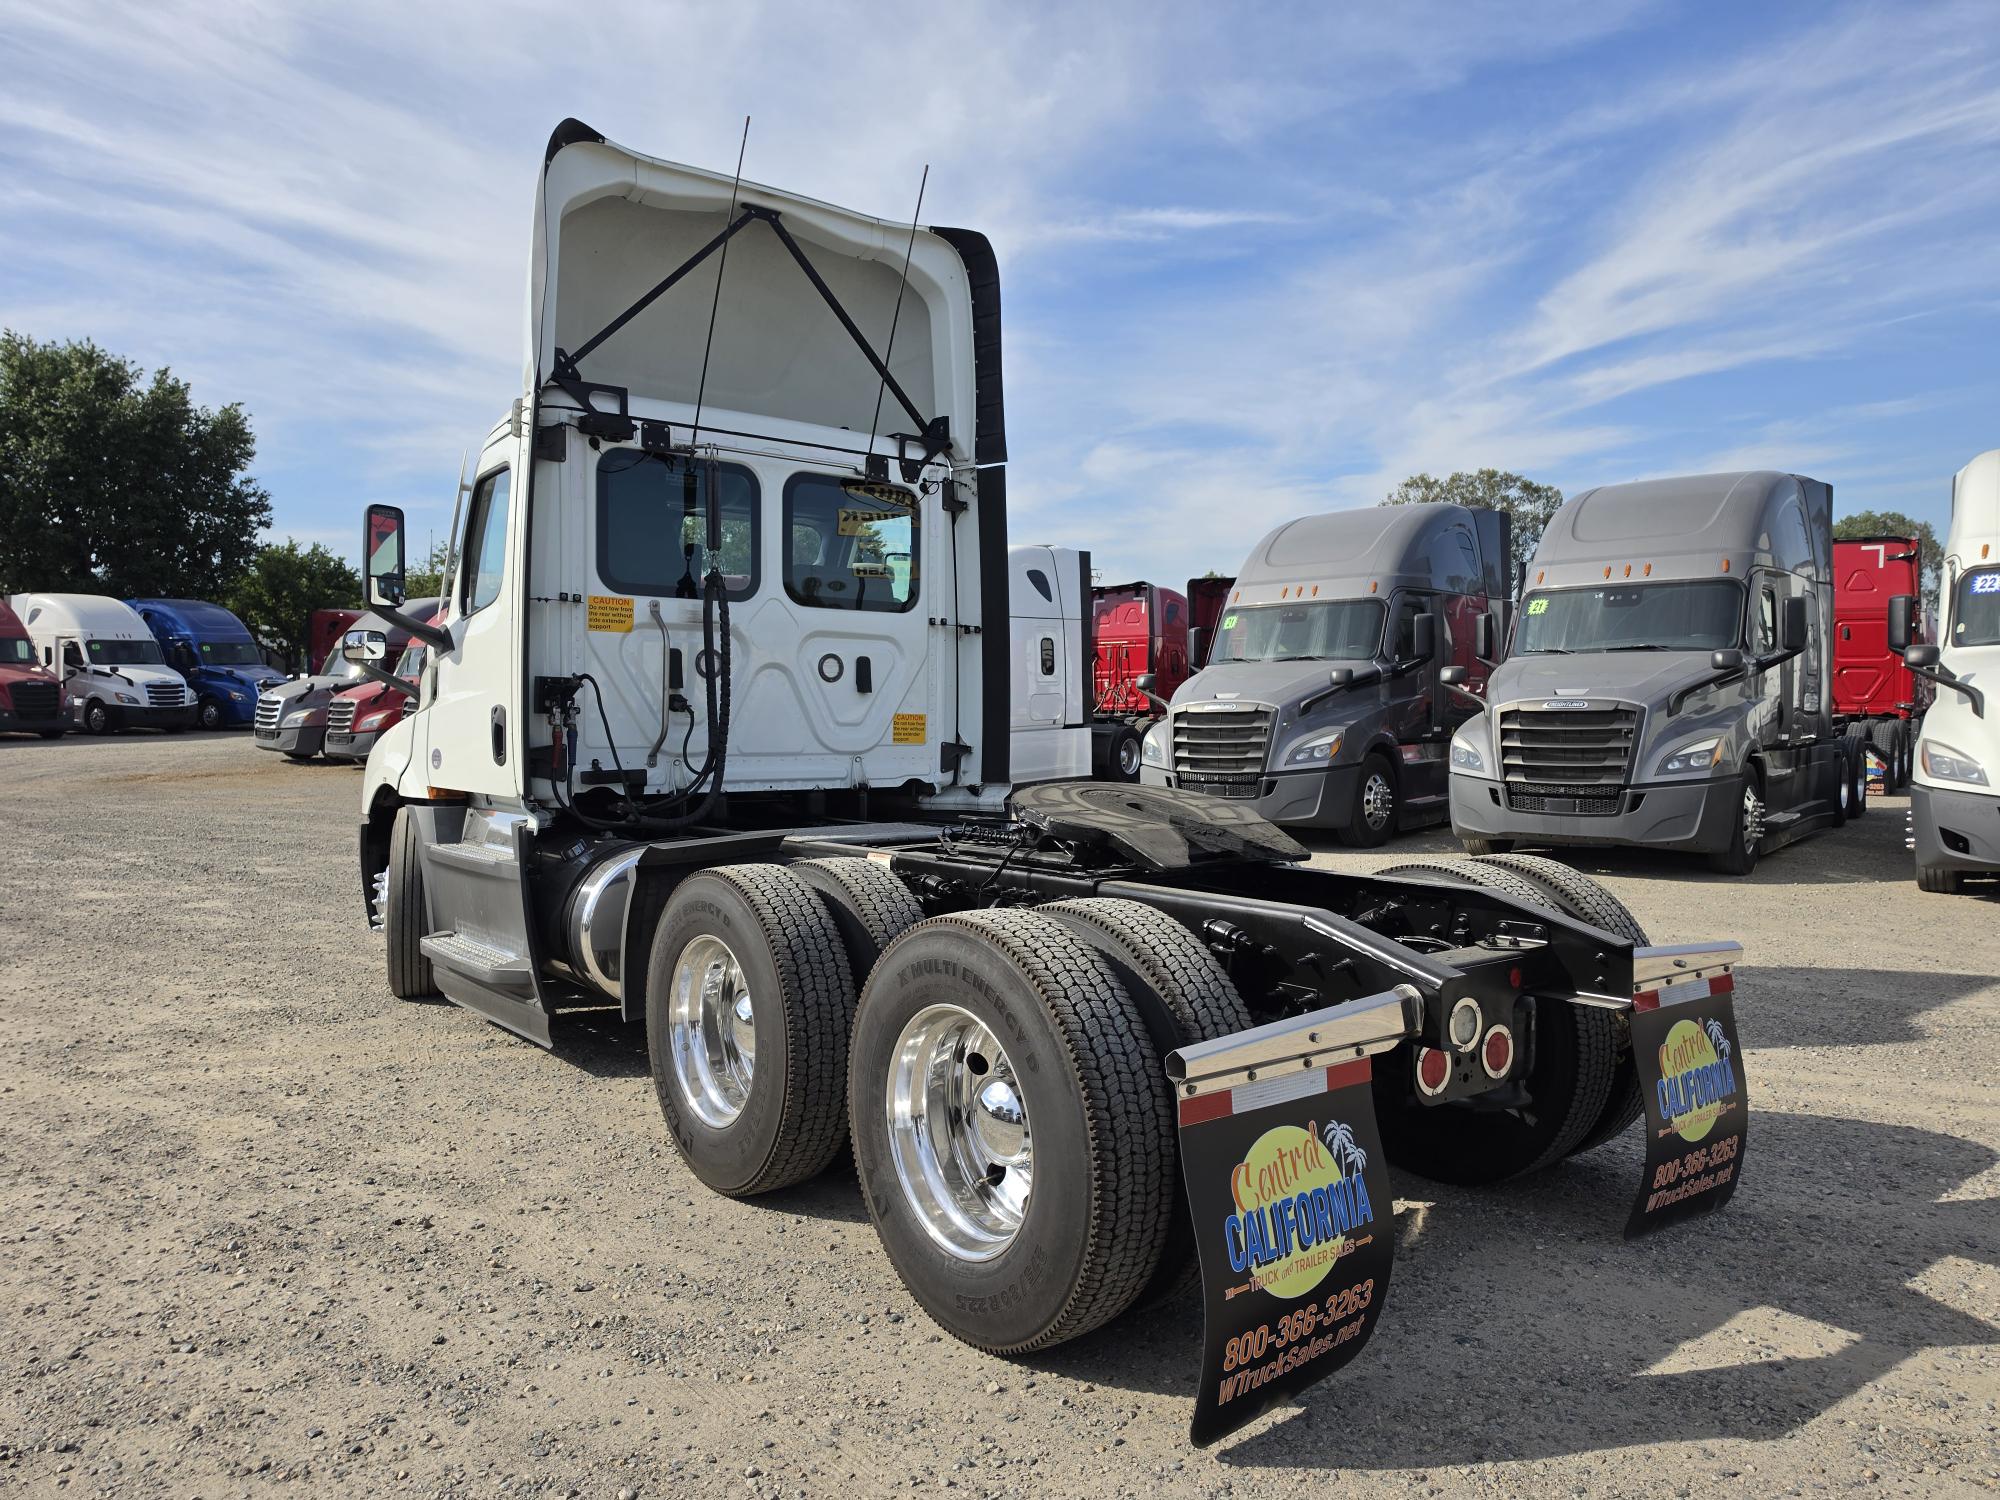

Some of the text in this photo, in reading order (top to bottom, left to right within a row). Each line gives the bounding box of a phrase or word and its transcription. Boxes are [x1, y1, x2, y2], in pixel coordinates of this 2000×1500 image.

[593, 597, 630, 606] CAUTION
[1979, 577, 1997, 590] 22
[896, 713, 924, 721] CAUTION
[910, 958, 958, 980] MULTI
[961, 966, 1028, 1043] ENERGY
[1025, 1051, 1040, 1073] D
[1658, 1016, 1708, 1080] Central
[1657, 1057, 1736, 1121] CALIFORNIA
[1694, 1109, 1713, 1126] TRAILER
[1231, 1119, 1326, 1213] Central
[1645, 1161, 1734, 1214] WTruckSales.net
[1653, 1134, 1739, 1190] 800-366-3263
[1225, 1172, 1374, 1273] CALIFORNIA
[1248, 1238, 1356, 1293] TRUCK and TRAILER SALES
[1223, 1278, 1374, 1372] 800-366-3263
[1218, 1313, 1366, 1407] WTruckSales.net
